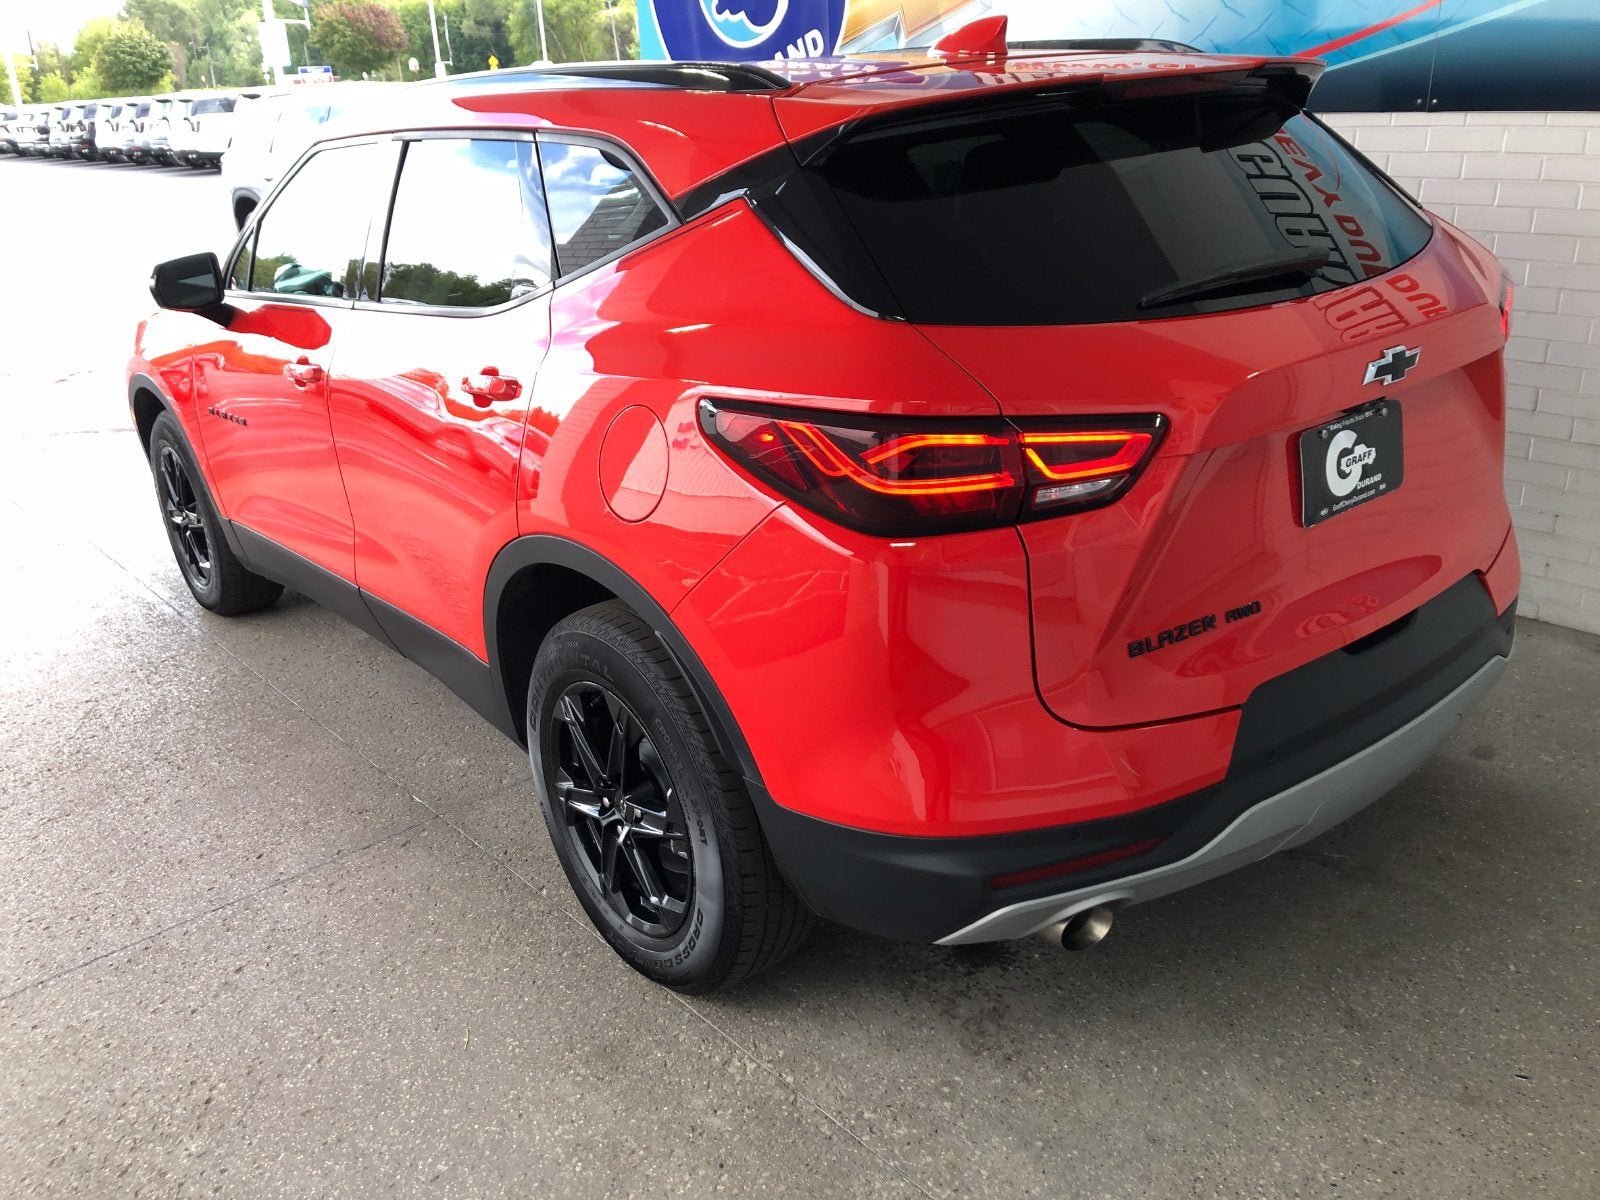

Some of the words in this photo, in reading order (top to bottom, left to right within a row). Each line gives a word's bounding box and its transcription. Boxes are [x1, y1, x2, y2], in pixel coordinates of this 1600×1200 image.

[1345, 449, 1373, 468] GRAFF
[1356, 473, 1382, 489] DURAND
[1127, 613, 1217, 658] BLAZER
[1225, 600, 1262, 623] AWD
